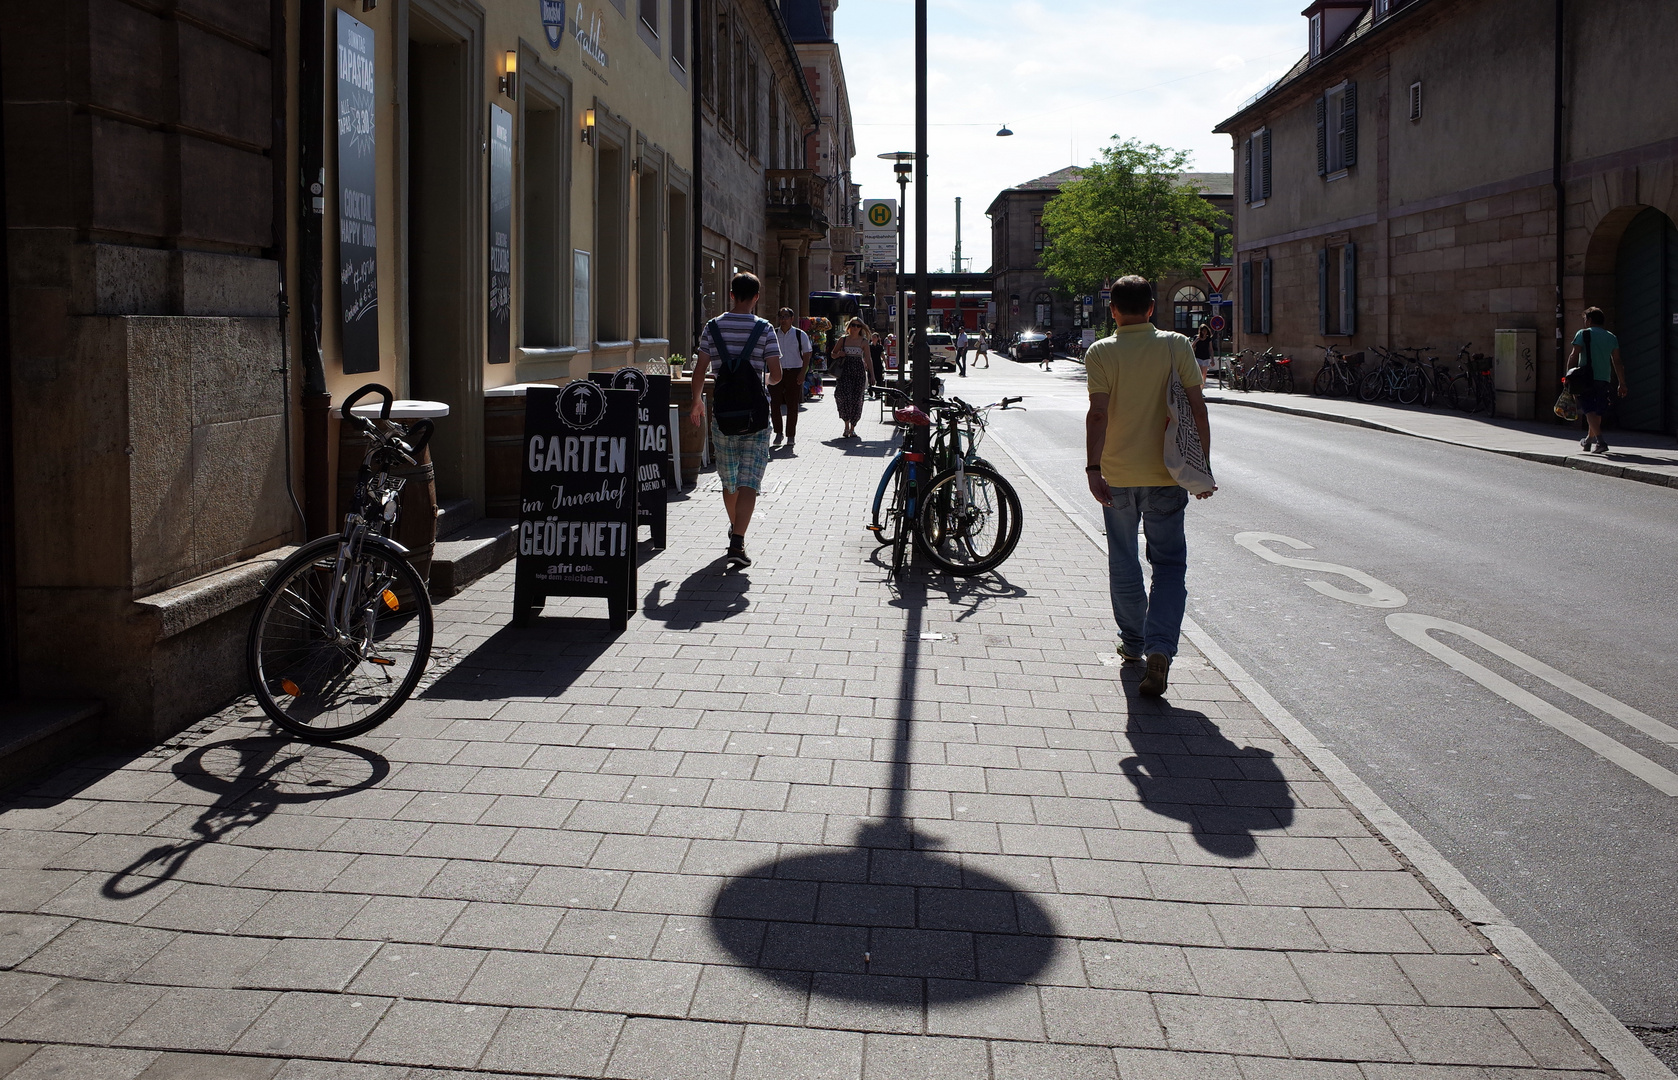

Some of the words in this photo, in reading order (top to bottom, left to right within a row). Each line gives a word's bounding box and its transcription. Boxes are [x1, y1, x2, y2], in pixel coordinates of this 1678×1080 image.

[348, 29, 365, 54] SONNTAG
[338, 44, 374, 94] TAPASTAG
[338, 115, 351, 135] TAPAS
[344, 187, 373, 222] COCKTAIL
[874, 208, 886, 221] H
[340, 218, 360, 245] HAPPY
[362, 223, 377, 247] HOUR
[575, 398, 587, 413] afri
[528, 434, 627, 473] GARTEN
[522, 498, 544, 513] im
[550, 475, 626, 509] Innenhof
[641, 480, 660, 492] ABEND
[519, 515, 628, 557] GEÖFFNET!
[547, 562, 572, 574] afri
[575, 564, 594, 573] cola.
[563, 574, 608, 584] zeichen.
